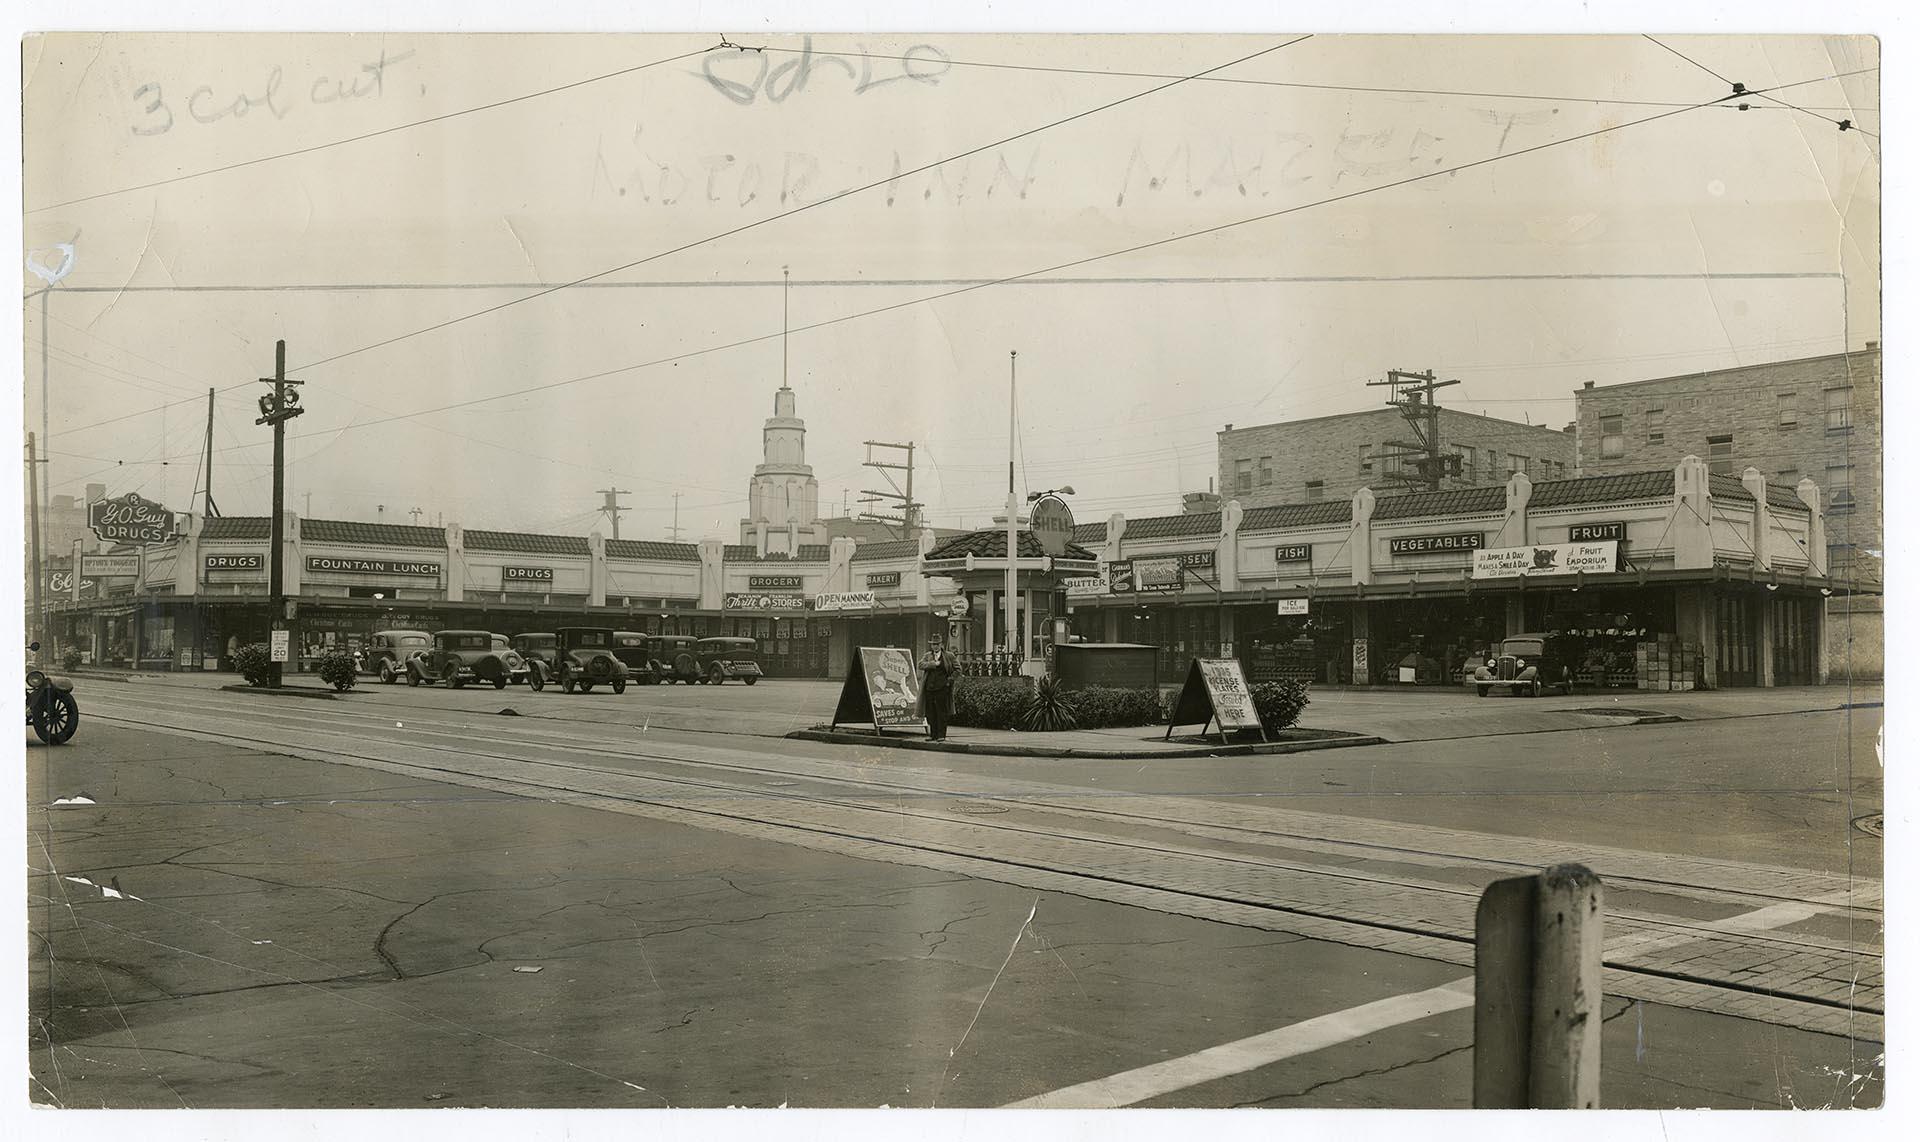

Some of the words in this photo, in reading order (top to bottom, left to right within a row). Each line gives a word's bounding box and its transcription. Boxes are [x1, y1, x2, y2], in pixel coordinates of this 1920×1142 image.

[131, 81, 174, 136] 3
[1034, 516, 1072, 532] SHELL
[107, 526, 161, 540] DRUGS
[1572, 525, 1618, 540] FRUIT
[1392, 536, 1478, 551] VEGETABLES
[1277, 547, 1305, 558] FISH
[1487, 553, 1504, 561] APPLE
[1505, 552, 1511, 560] A
[1512, 551, 1525, 559] DAY
[1579, 547, 1603, 555] FRUIT
[207, 557, 258, 568] DRUGS
[312, 558, 385, 572] FOUNTAIN
[393, 563, 440, 574] LUNCH
[1518, 560, 1530, 568] DAY
[1566, 557, 1607, 566] EMPORIUM
[509, 568, 551, 578] DRUGS
[750, 577, 800, 586] GROCERY
[867, 575, 897, 584] BAKERY
[1067, 578, 1107, 588] BUTTER
[726, 597, 758, 609] Thrift
[771, 598, 803, 607] STORES
[816, 594, 841, 609] OPEN
[273, 649, 286, 657] 20
[881, 662, 908, 675] SHELL
[1208, 677, 1240, 686] LICENSE
[1214, 685, 1240, 693] PLATES
[876, 709, 895, 718] SAVES
[1223, 708, 1246, 718] HERE
